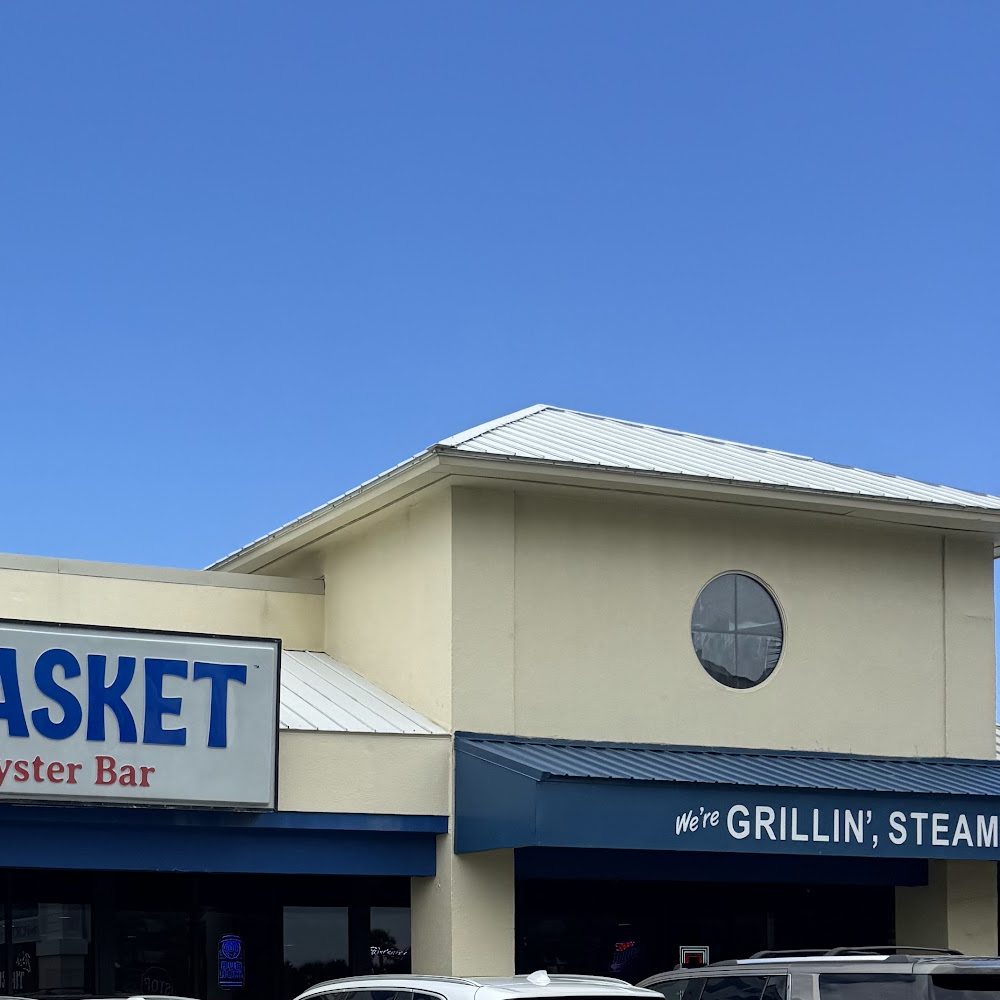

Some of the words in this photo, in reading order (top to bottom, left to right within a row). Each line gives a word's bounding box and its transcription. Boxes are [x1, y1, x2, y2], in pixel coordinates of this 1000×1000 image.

[95, 755, 155, 787] Bar
[675, 806, 719, 836] We're
[888, 811, 999, 848] STEAM
